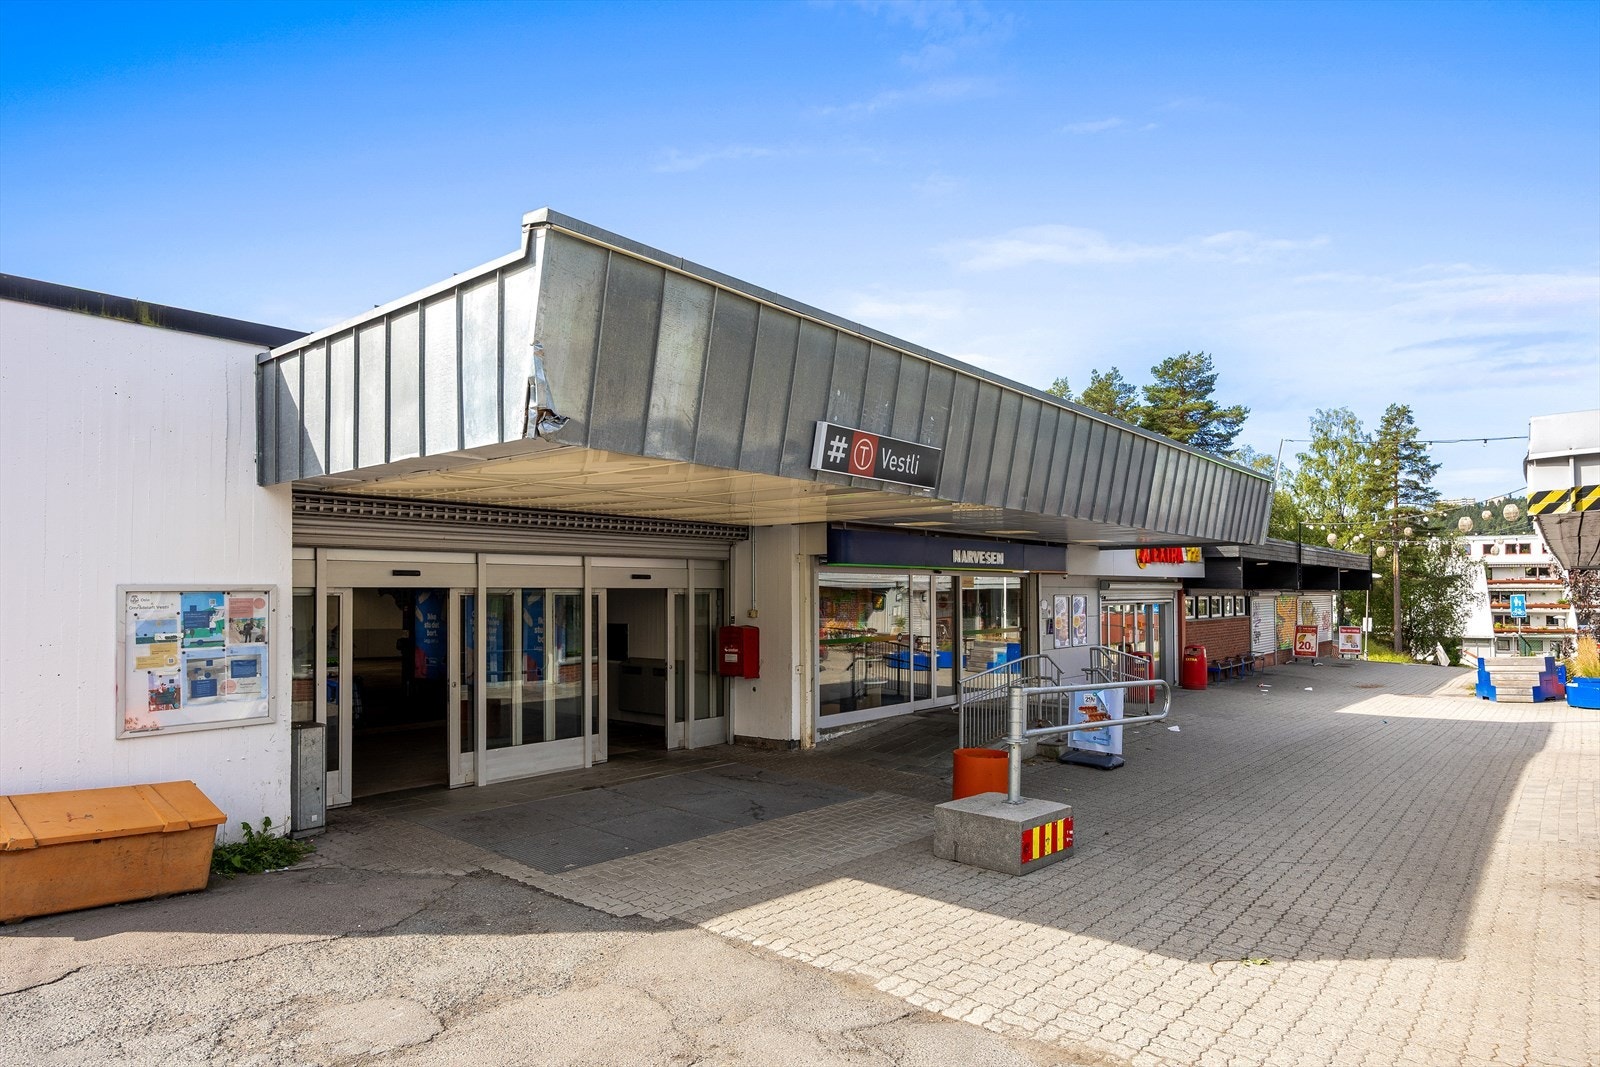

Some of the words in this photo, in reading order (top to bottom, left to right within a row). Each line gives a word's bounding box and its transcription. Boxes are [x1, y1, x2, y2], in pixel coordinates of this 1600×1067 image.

[881, 447, 920, 475] Vestli
[952, 549, 1005, 565] NARVESEN
[1298, 641, 1311, 650] 20
